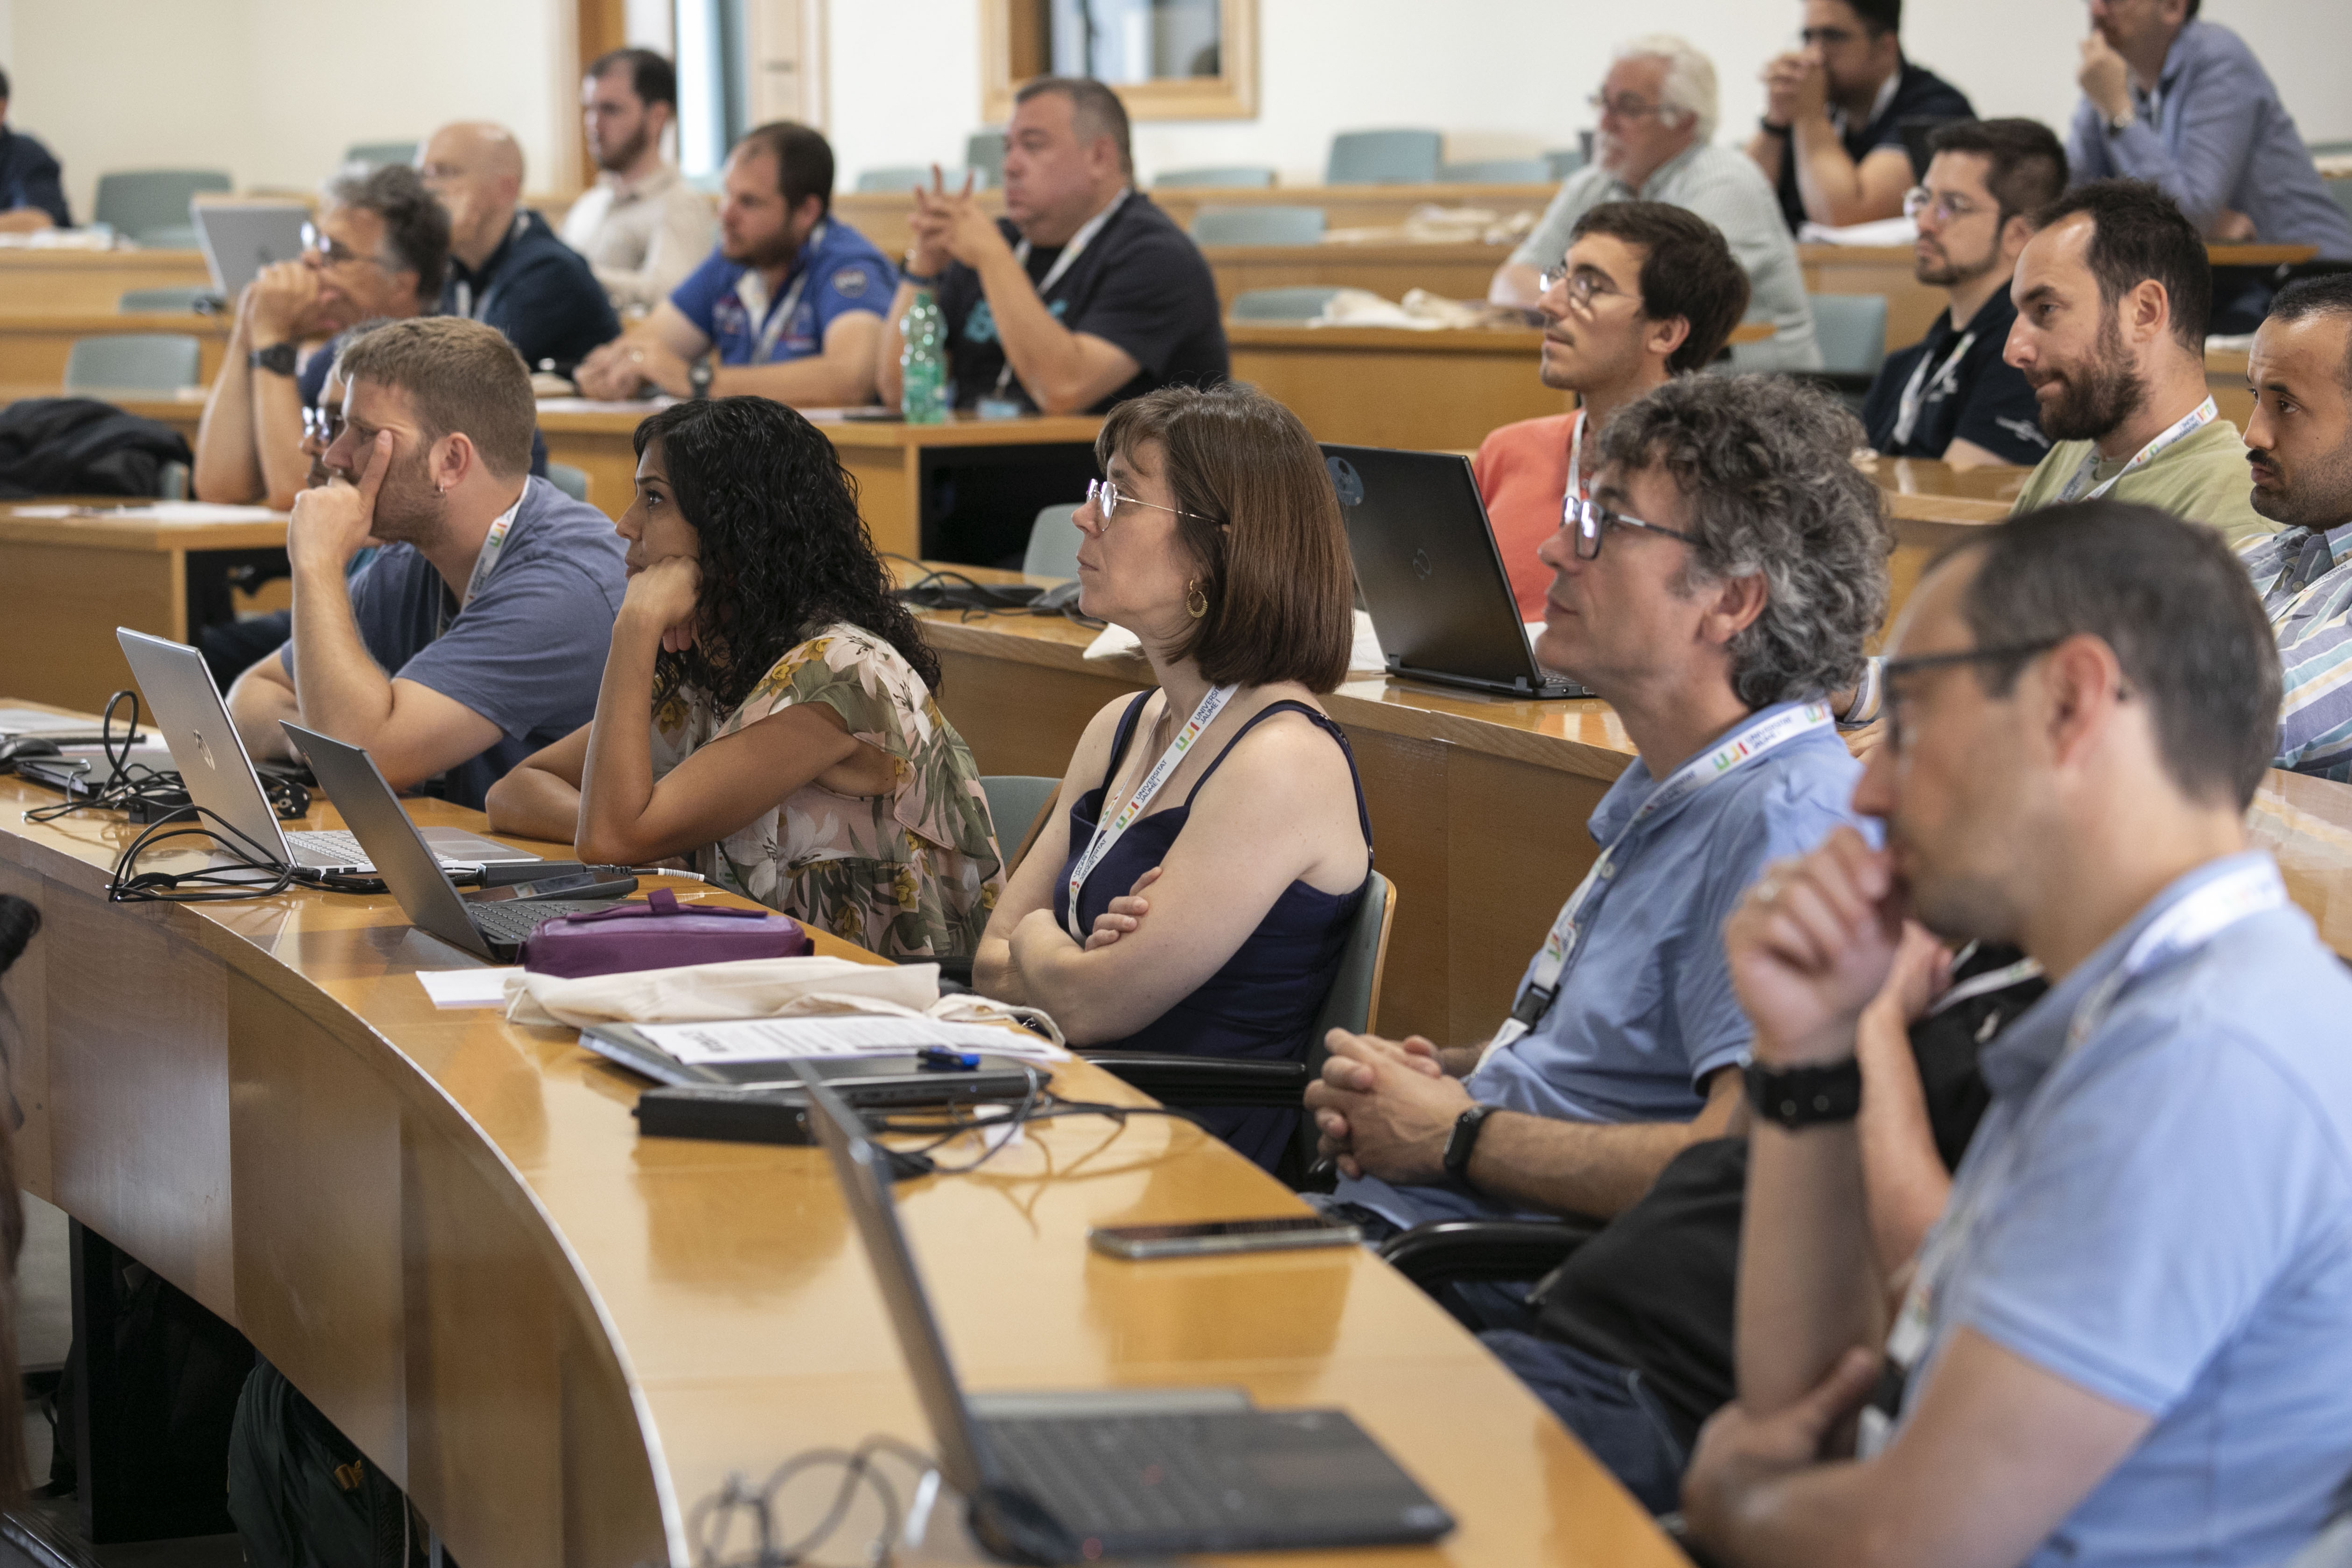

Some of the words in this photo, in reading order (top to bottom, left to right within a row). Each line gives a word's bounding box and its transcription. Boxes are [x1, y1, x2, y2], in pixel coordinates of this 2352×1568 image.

[1194, 686, 1222, 721] UNIVERSIT
[1200, 702, 1219, 724] JAUME
[1135, 759, 1167, 800] UNIVERSITAT
[1141, 781, 1158, 803] JAUME
